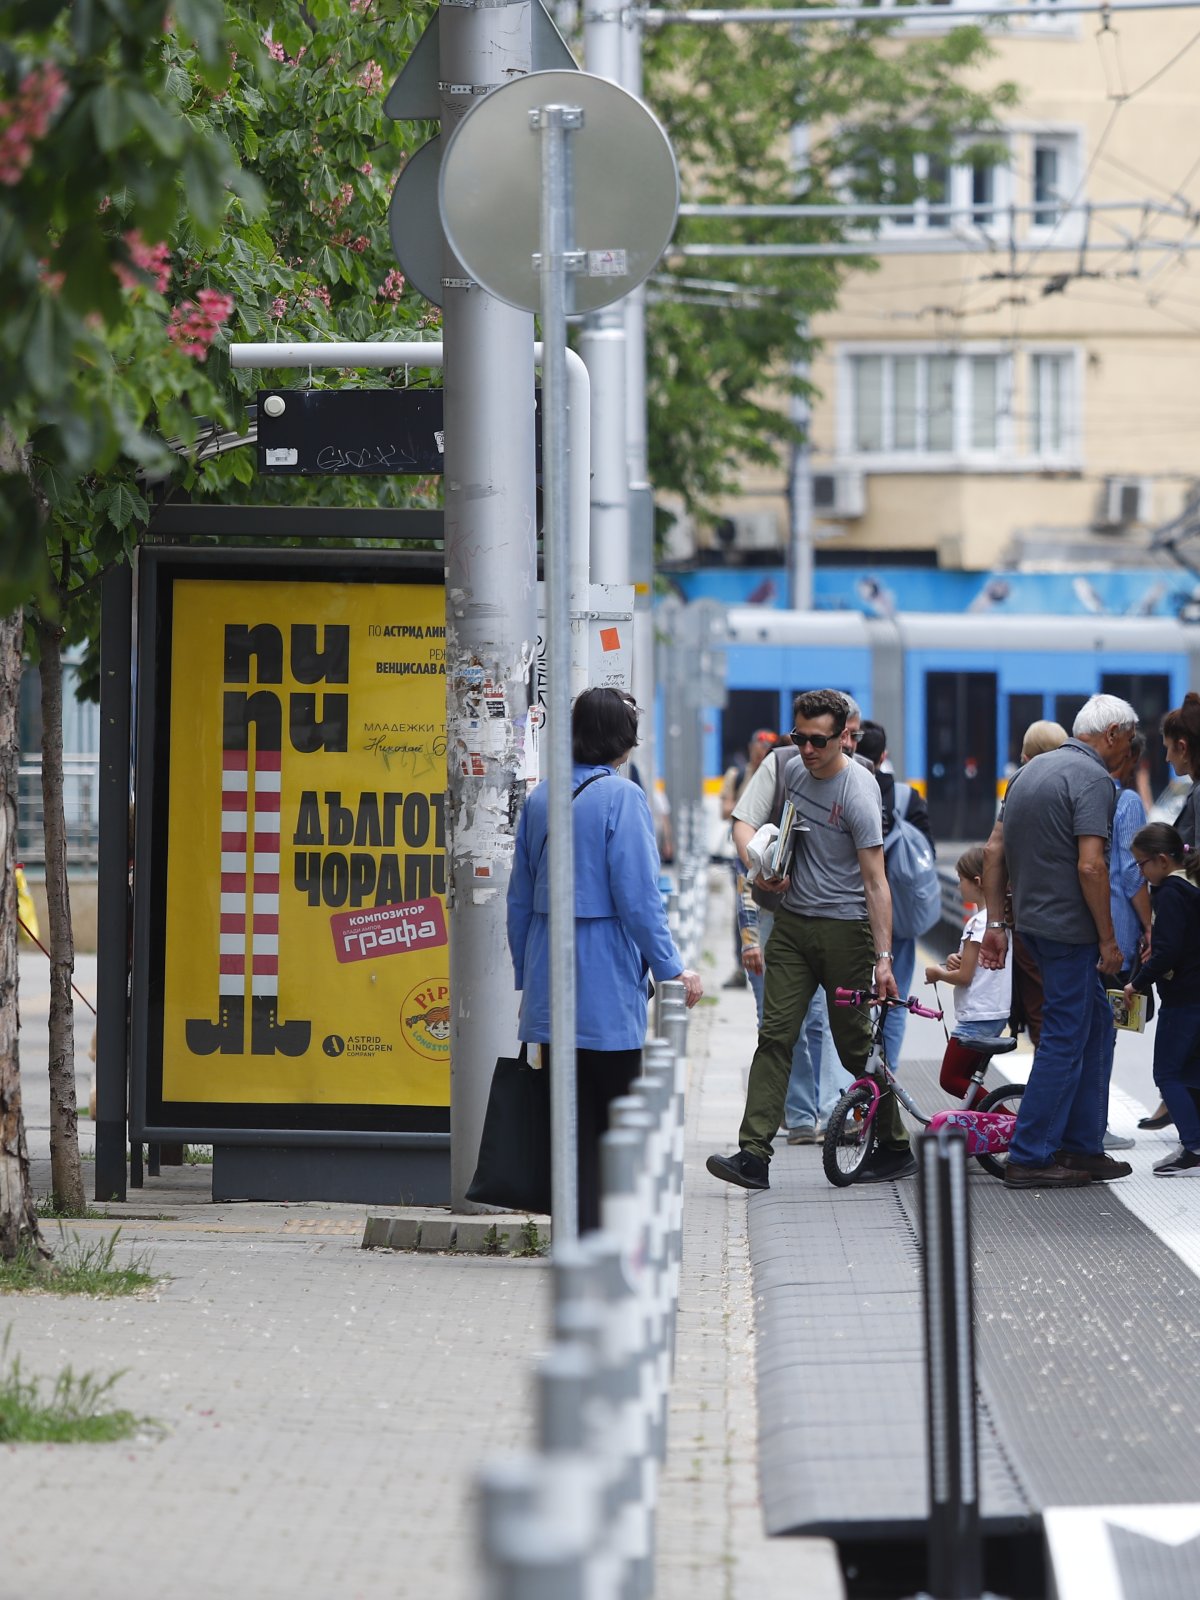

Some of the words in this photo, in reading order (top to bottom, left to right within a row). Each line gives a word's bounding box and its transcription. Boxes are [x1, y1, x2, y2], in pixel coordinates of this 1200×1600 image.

[368, 624, 382, 637] ПО
[383, 625, 424, 639] АСТРИД
[376, 662, 438, 675] ВЕНЦИСЛАВ
[364, 723, 435, 732] МЛАДЕЖКИ
[349, 905, 425, 927] КОМПОЗИТОР
[347, 1036, 382, 1044] ASTRID
[346, 1044, 393, 1052] LINDGREN
